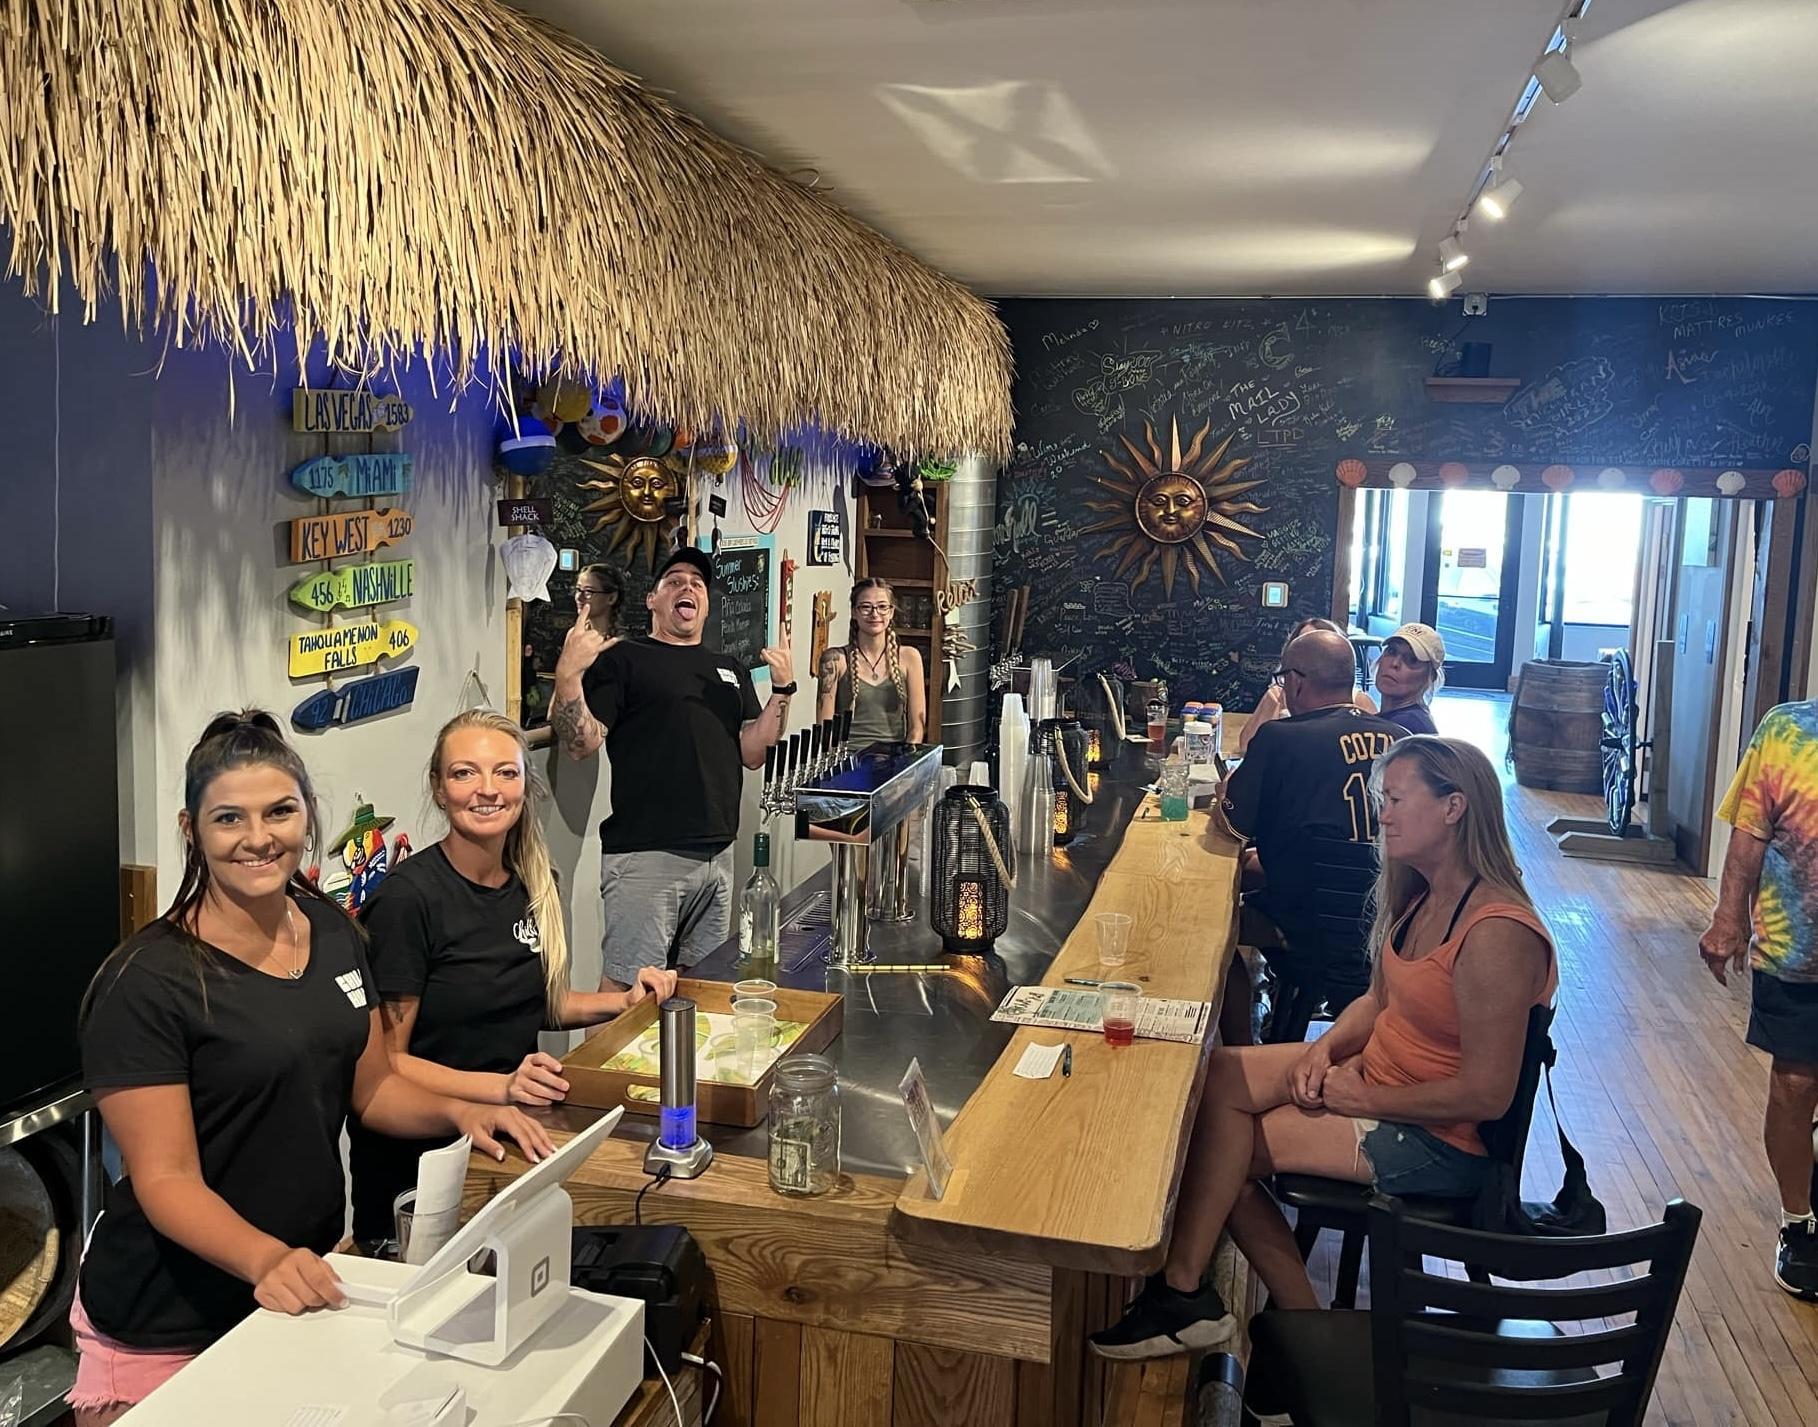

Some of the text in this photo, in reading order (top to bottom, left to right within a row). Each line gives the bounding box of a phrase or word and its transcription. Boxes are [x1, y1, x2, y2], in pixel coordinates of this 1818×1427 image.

[1230, 380, 1256, 398] THE
[305, 392, 331, 431] LAS
[332, 392, 373, 431] VEGAS
[1229, 387, 1280, 420] MAIL
[1256, 391, 1301, 427] LADY
[308, 466, 334, 490] 1175
[511, 513, 540, 521] SHACK
[512, 505, 536, 514] SHELL
[302, 516, 412, 561] KEY WEST 1230
[311, 581, 334, 607] 456
[299, 625, 411, 655] TAHQUAMENON 406
[324, 646, 357, 671] FALLS
[1339, 732, 1395, 765] COZZ
